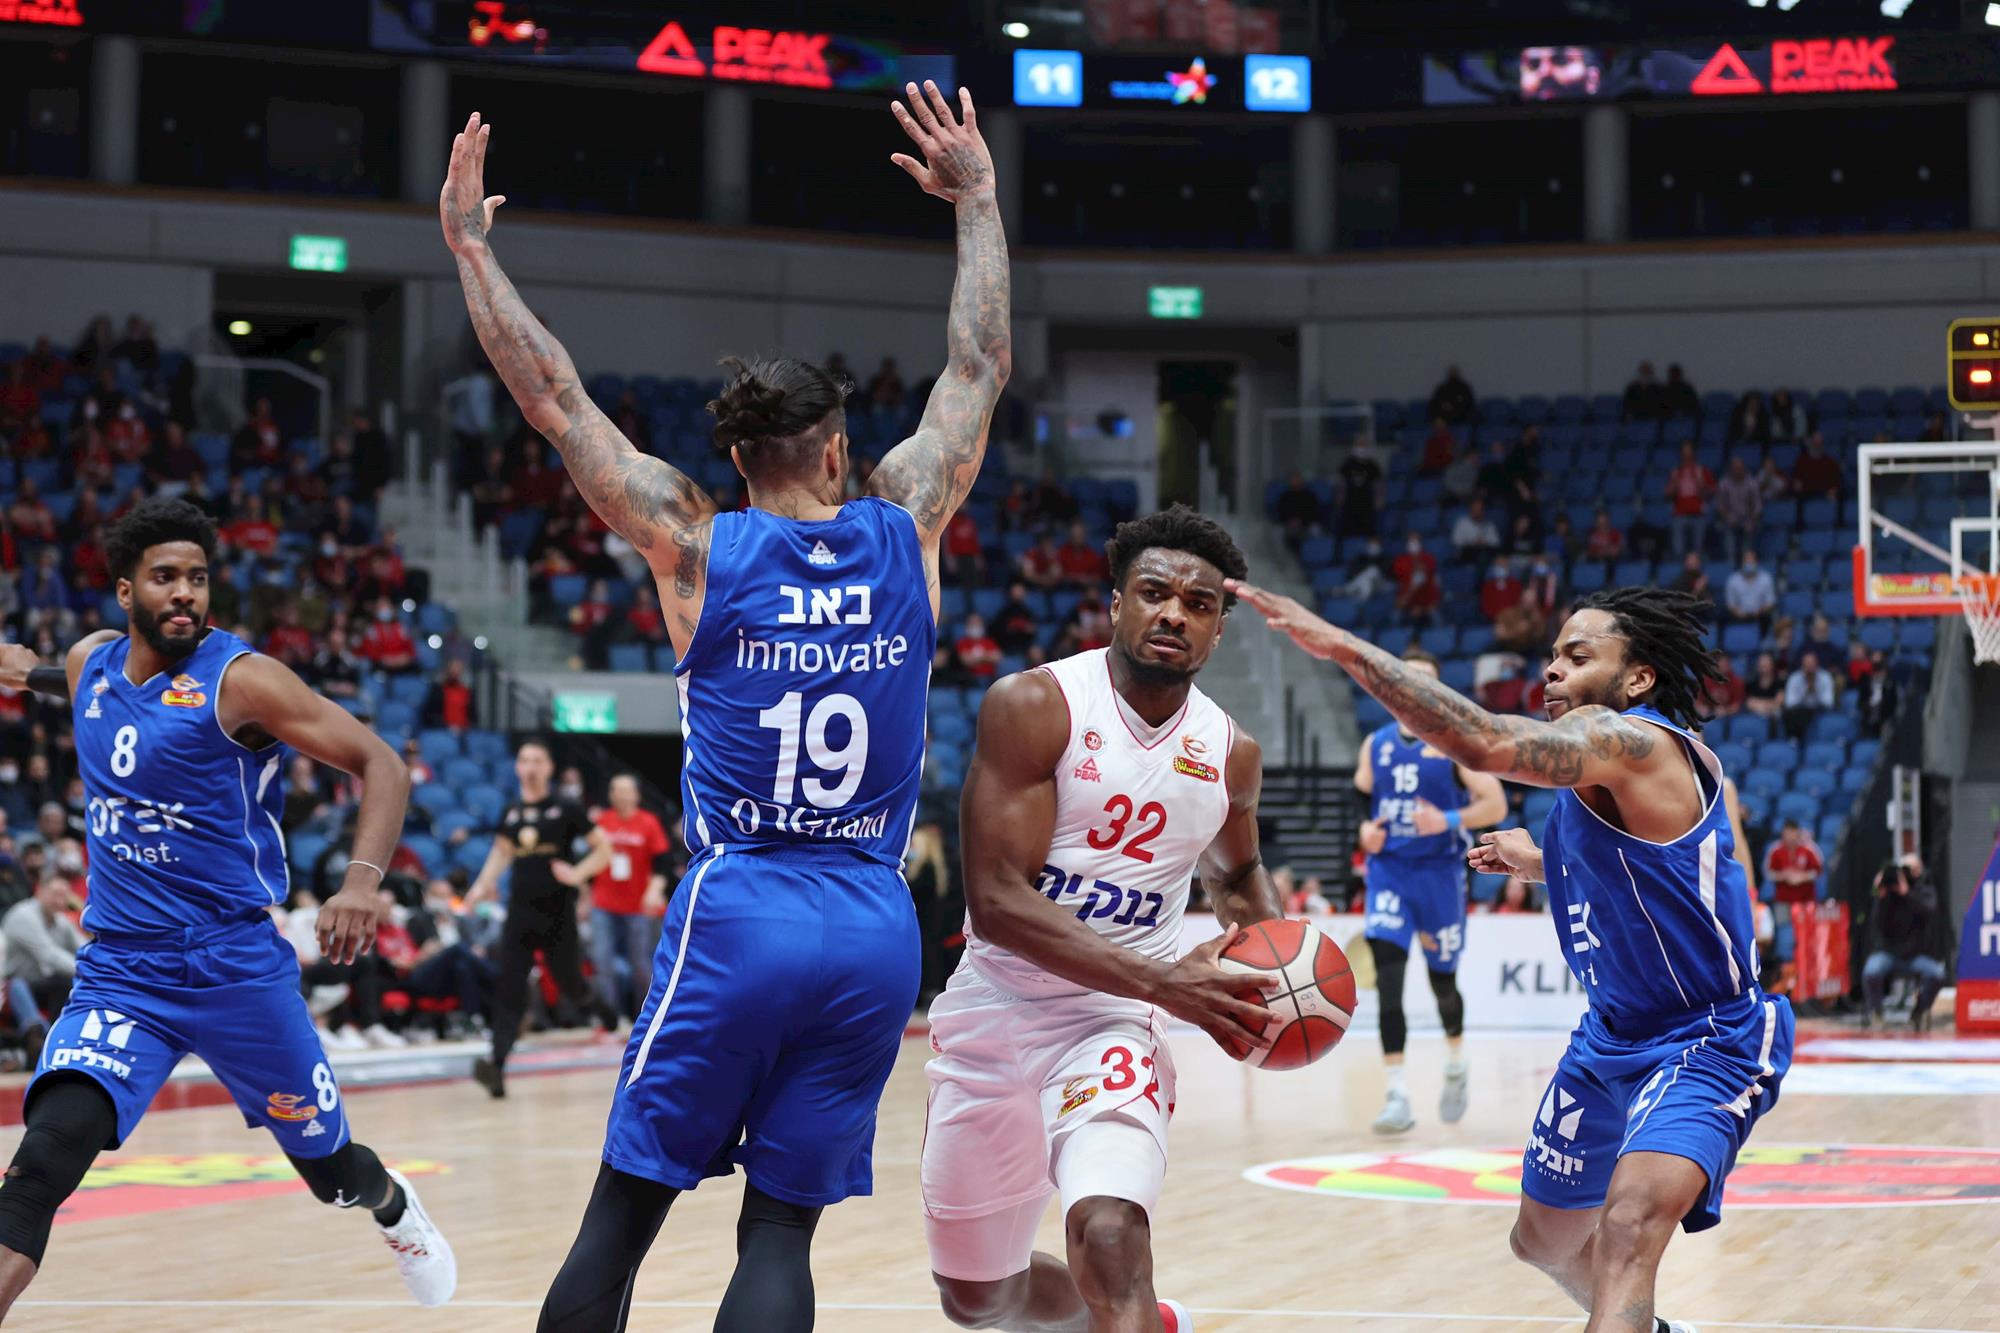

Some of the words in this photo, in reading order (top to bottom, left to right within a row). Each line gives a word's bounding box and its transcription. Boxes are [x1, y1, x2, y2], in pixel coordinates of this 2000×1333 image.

[712, 25, 830, 77] PEAK
[1771, 36, 1896, 79] PEAK
[1028, 63, 1072, 95] 11
[1250, 67, 1298, 100] 12
[778, 584, 872, 625] באב
[736, 628, 908, 674] innovate
[110, 724, 139, 778] 8
[758, 690, 869, 809] 19
[1073, 768, 1102, 783] PEAK
[1391, 763, 1420, 794] 15
[1087, 793, 1168, 864] 32
[1436, 923, 1462, 962] 15
[1501, 962, 1587, 993] KLI
[311, 1061, 338, 1112] 8
